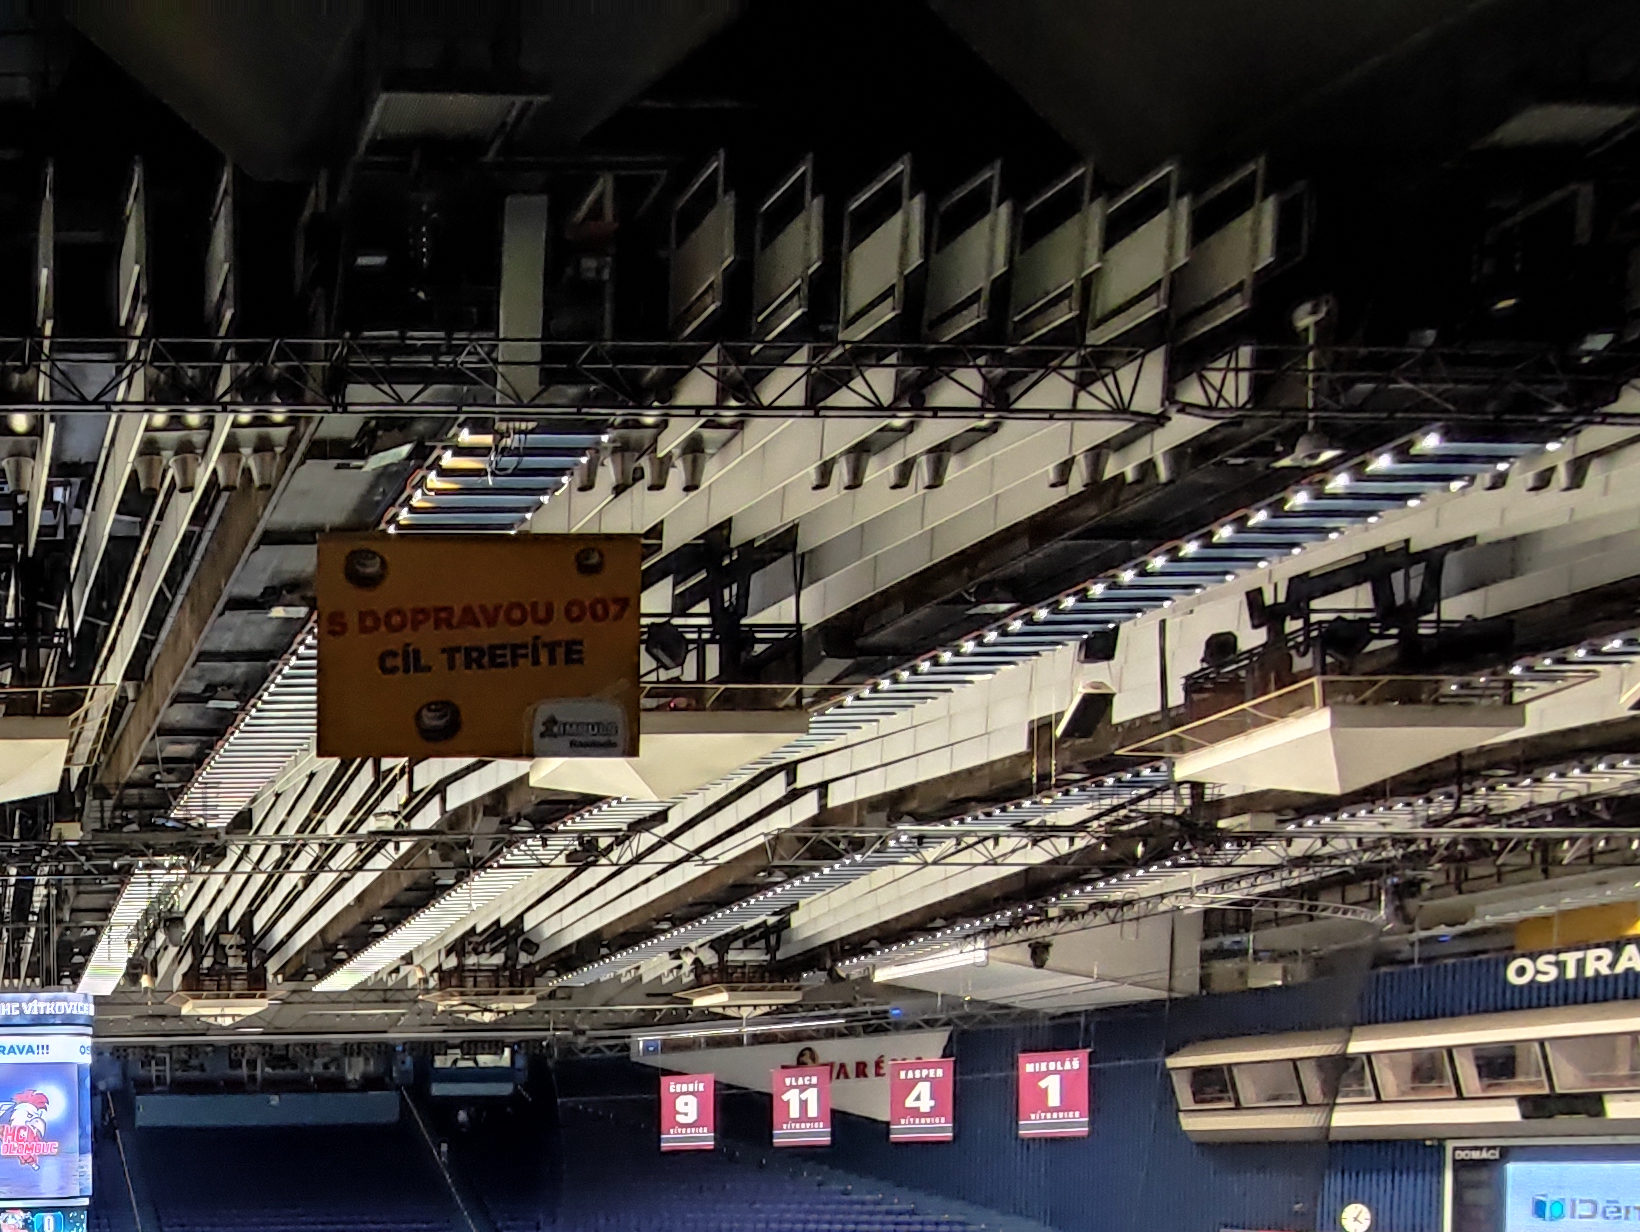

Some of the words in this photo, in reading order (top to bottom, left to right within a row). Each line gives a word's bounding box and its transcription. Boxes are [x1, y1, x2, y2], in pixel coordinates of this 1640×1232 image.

[326, 611, 349, 637] S
[358, 600, 555, 635] DOPRAVOU
[564, 597, 631, 624] 007
[378, 643, 432, 676] CÍL
[440, 635, 585, 672] TREFÍTE
[0, 1003, 20, 1016] HC
[899, 1067, 944, 1080] KASPER
[1025, 1057, 1081, 1073] MIKOLÁŠ
[781, 1086, 819, 1120] 11
[904, 1081, 936, 1114] 4
[1037, 1073, 1062, 1108] 1
[675, 1093, 698, 1125] 9
[1, 1141, 58, 1156] OLOMOUC
[4, 1125, 28, 1143] HC
